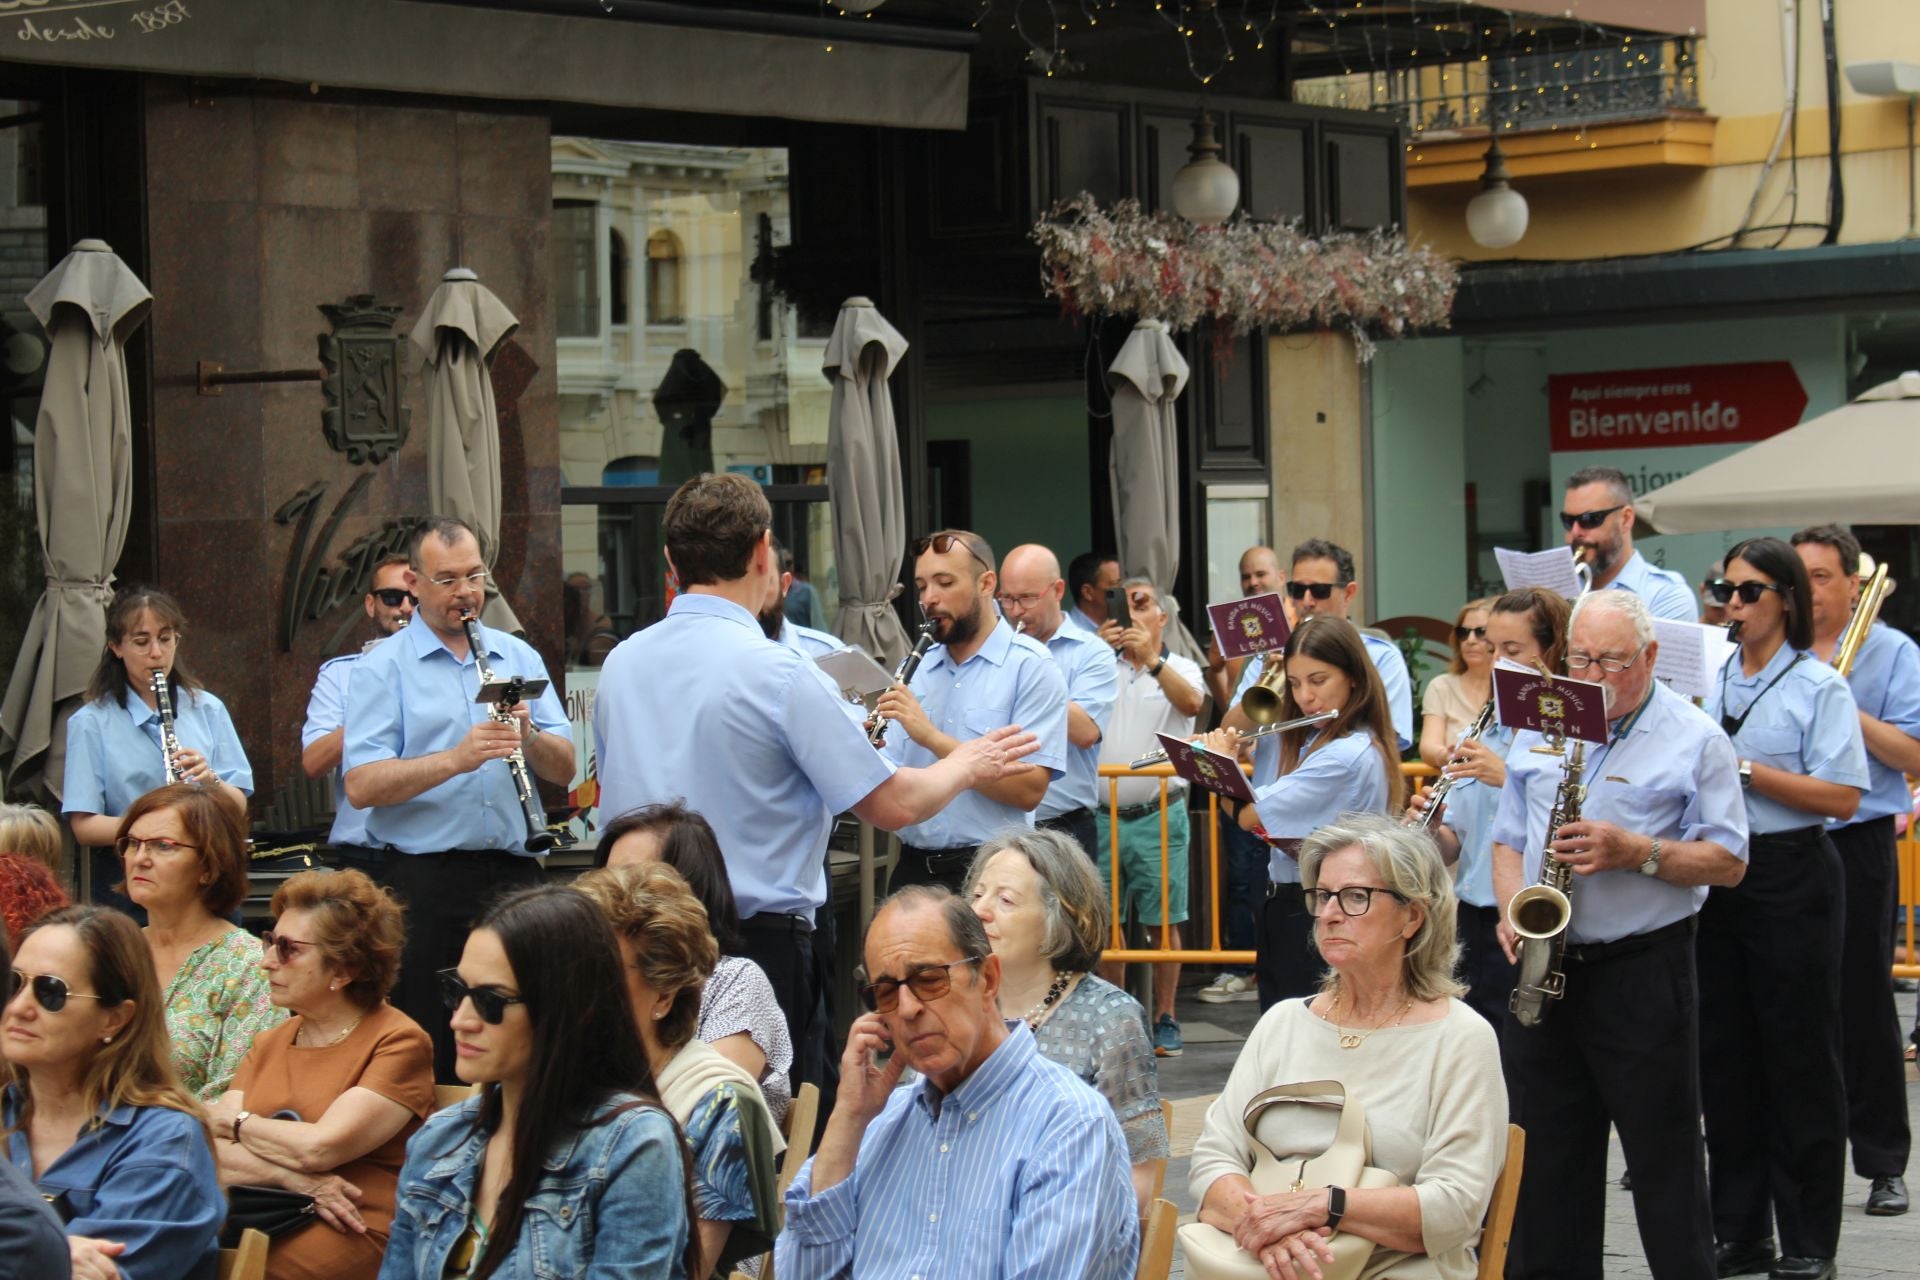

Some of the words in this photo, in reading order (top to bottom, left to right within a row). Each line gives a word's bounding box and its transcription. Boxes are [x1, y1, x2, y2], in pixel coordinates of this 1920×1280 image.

[17, 16, 115, 42] desde
[130, 0, 192, 33] 1887
[1604, 384, 1659, 400] siempre
[1661, 383, 1692, 395] eres
[1568, 401, 1740, 438] Bienvenido
[1239, 637, 1277, 652] LEÓN
[1517, 682, 1538, 701] BANDA
[1556, 685, 1585, 712] MÚSICA
[1526, 716, 1581, 734] LEÓN
